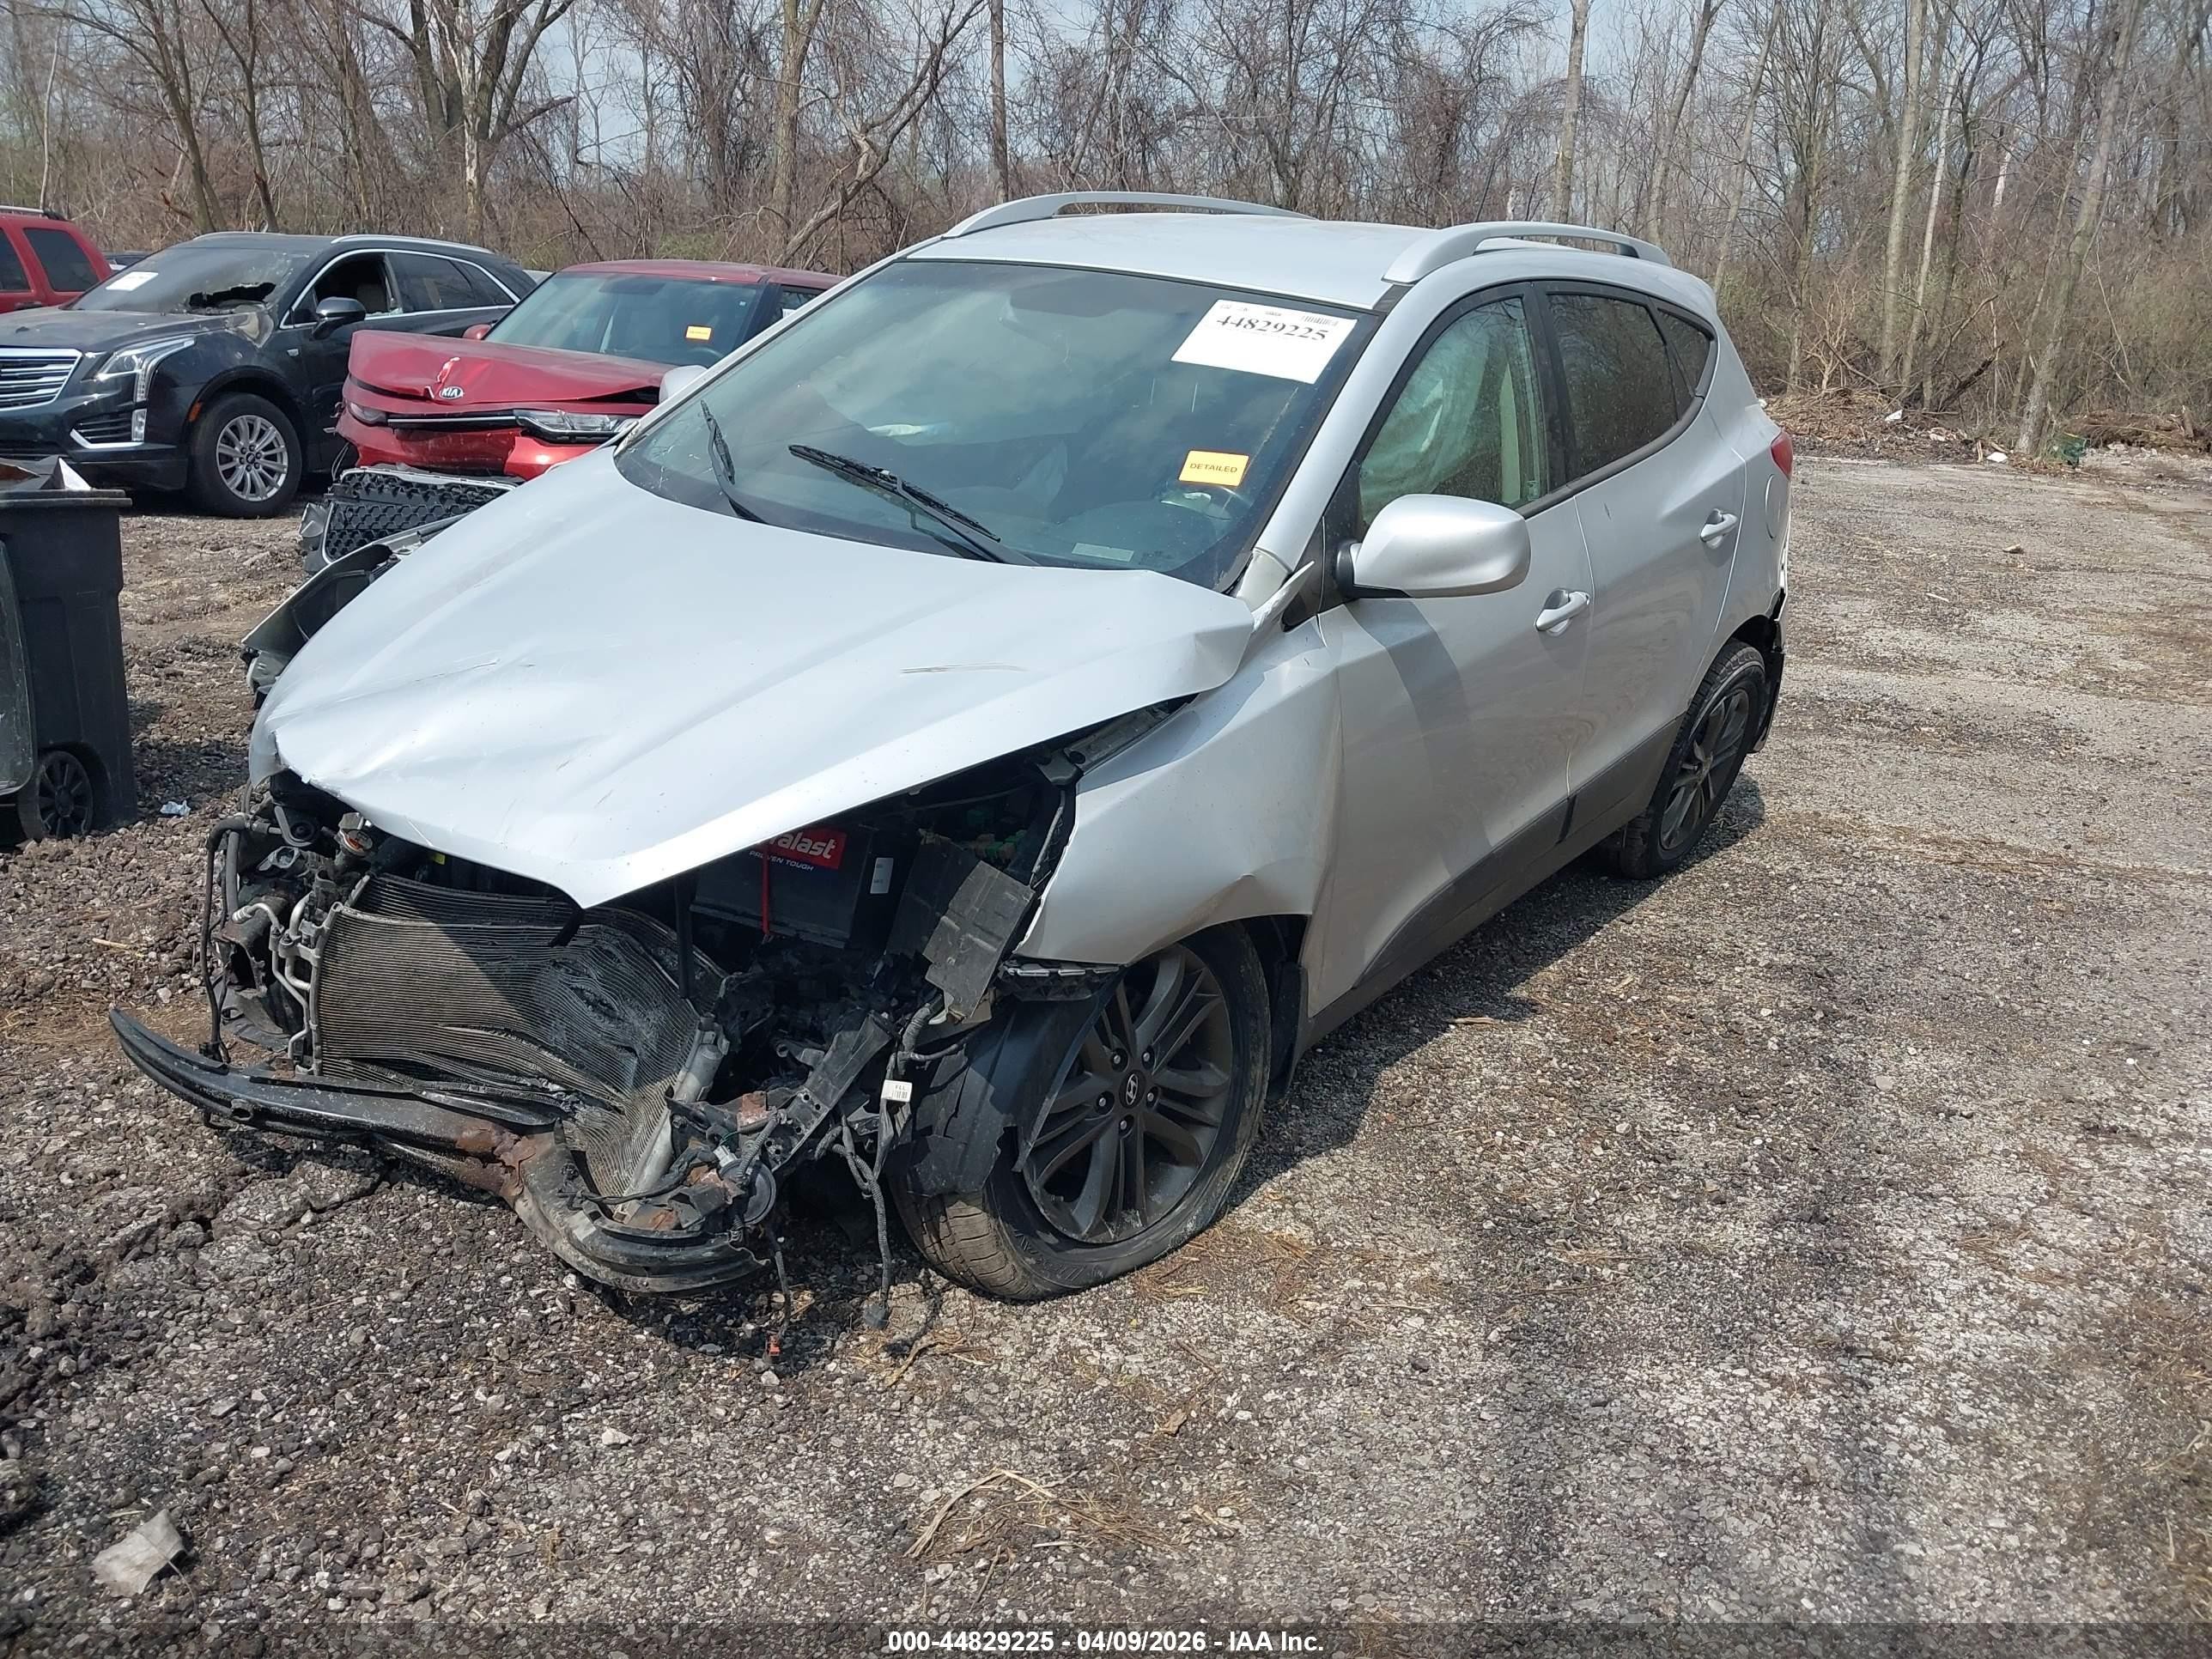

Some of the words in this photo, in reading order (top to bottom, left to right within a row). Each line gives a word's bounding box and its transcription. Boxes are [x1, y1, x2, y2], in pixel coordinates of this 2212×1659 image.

[1216, 315, 1329, 341] 44829225
[1189, 463, 1237, 473] DETAILED
[786, 859, 815, 872] TOUGH
